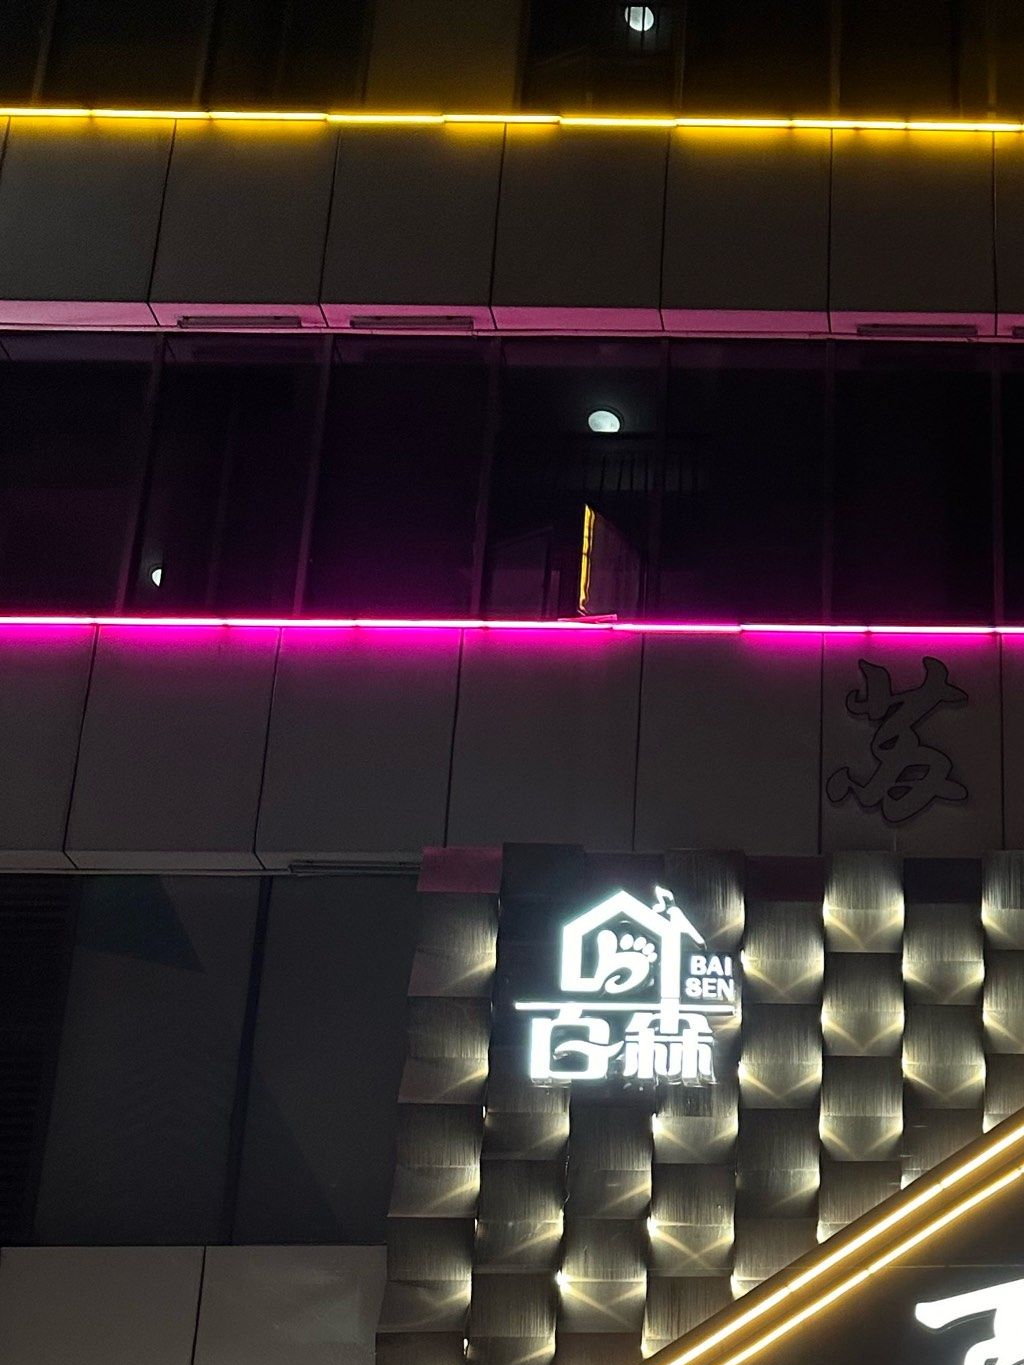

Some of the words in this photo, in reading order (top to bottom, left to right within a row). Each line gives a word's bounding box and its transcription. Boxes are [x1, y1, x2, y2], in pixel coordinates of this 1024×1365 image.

[690, 955, 732, 976] BAI
[685, 978, 734, 998] SEN
[515, 1001, 735, 1080] 百森
